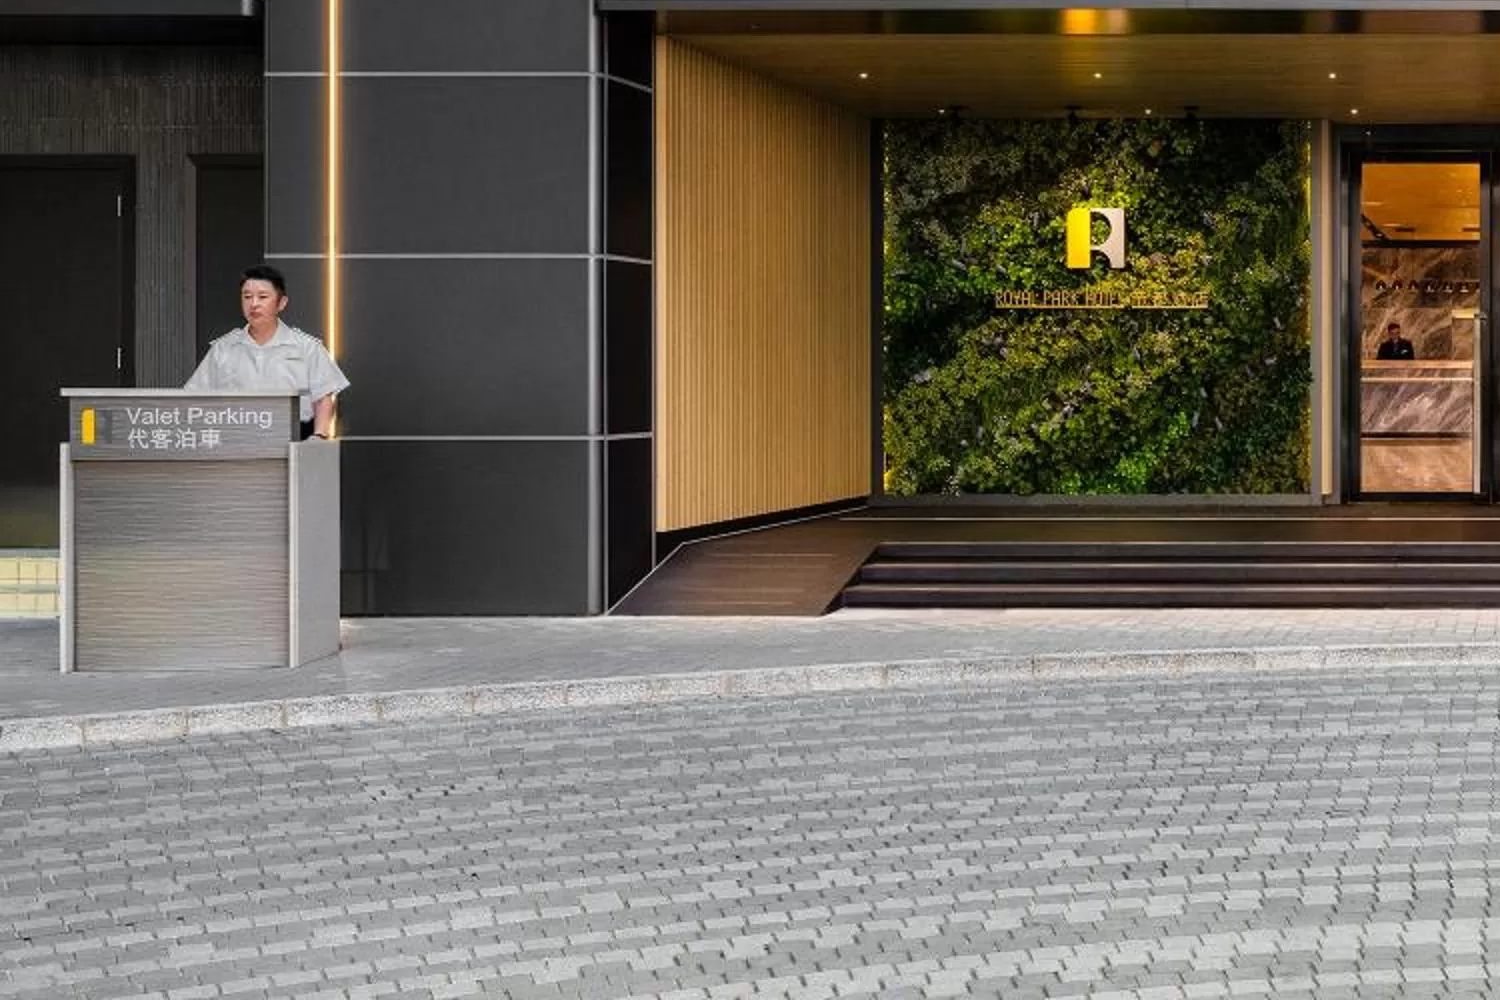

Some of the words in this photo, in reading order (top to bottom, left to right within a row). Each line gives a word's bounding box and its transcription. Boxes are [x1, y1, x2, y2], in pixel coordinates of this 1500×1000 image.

[125, 407, 180, 425] Valet
[187, 407, 273, 429] Parking
[127, 428, 221, 450] 代客泊車
